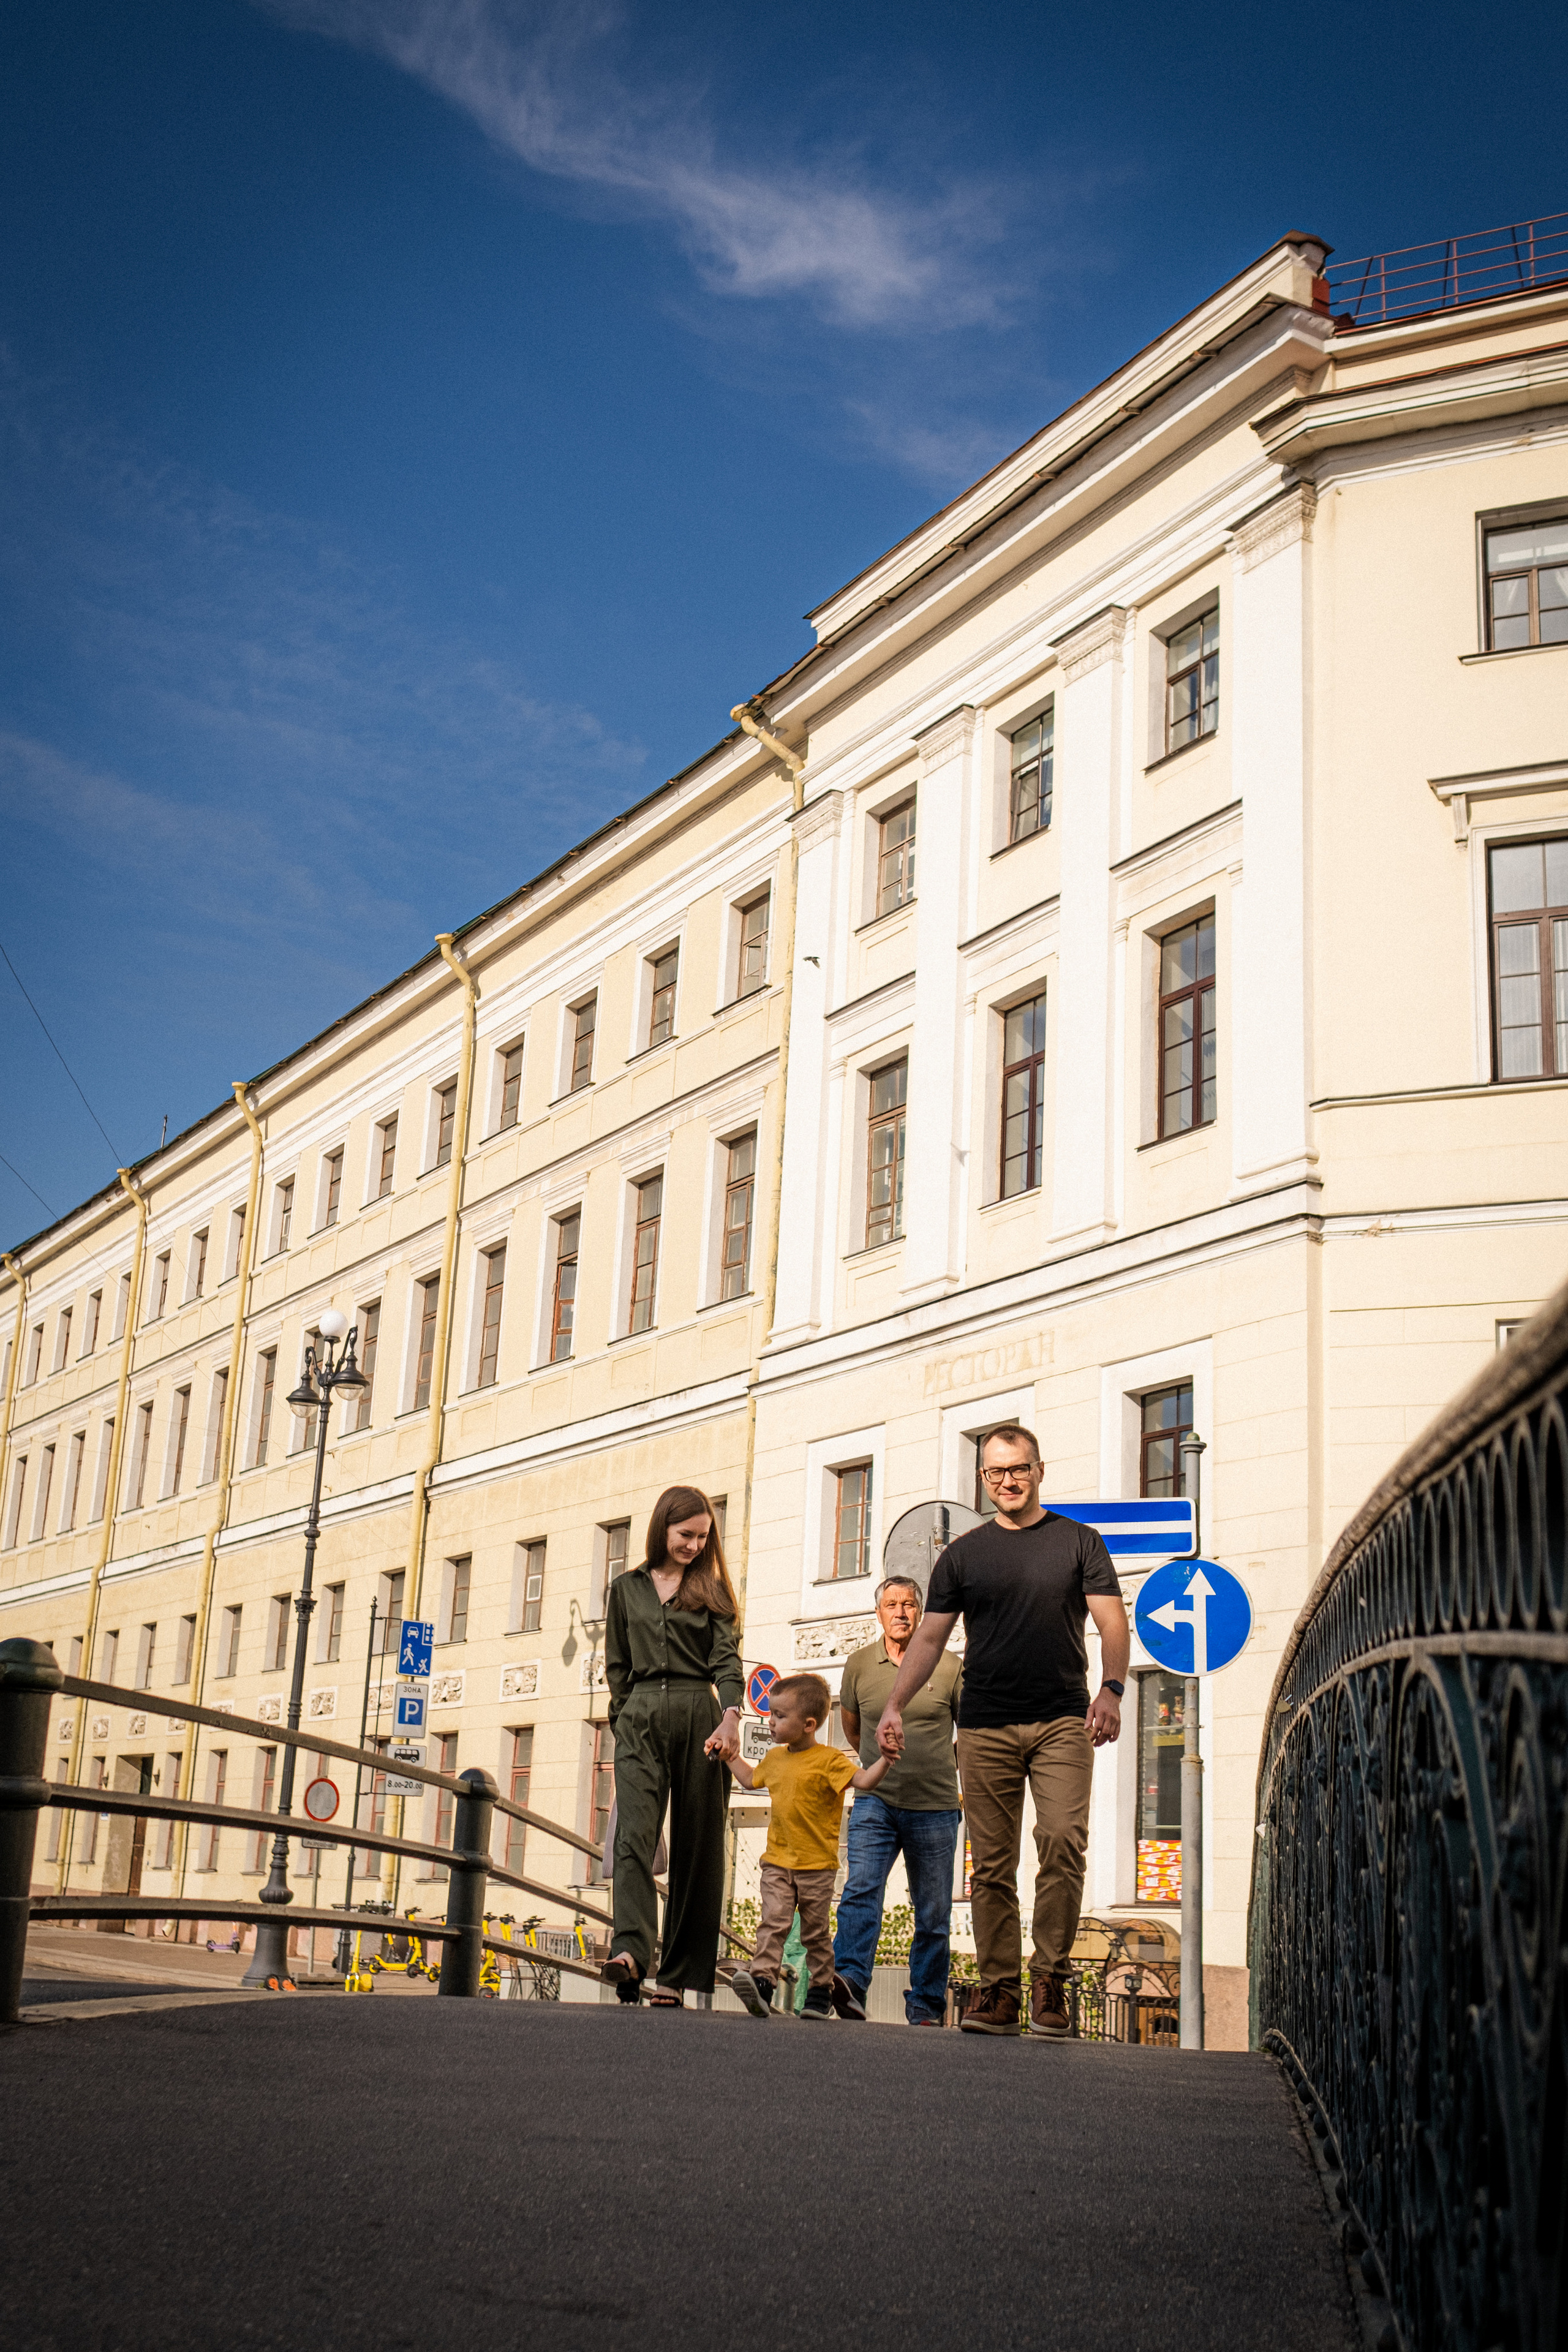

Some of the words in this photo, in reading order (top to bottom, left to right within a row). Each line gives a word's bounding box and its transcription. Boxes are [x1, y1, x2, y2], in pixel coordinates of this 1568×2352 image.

[404, 1700, 420, 1722] P
[747, 1746, 768, 1756] кро
[388, 1780, 423, 1790] 8.00-20.00
